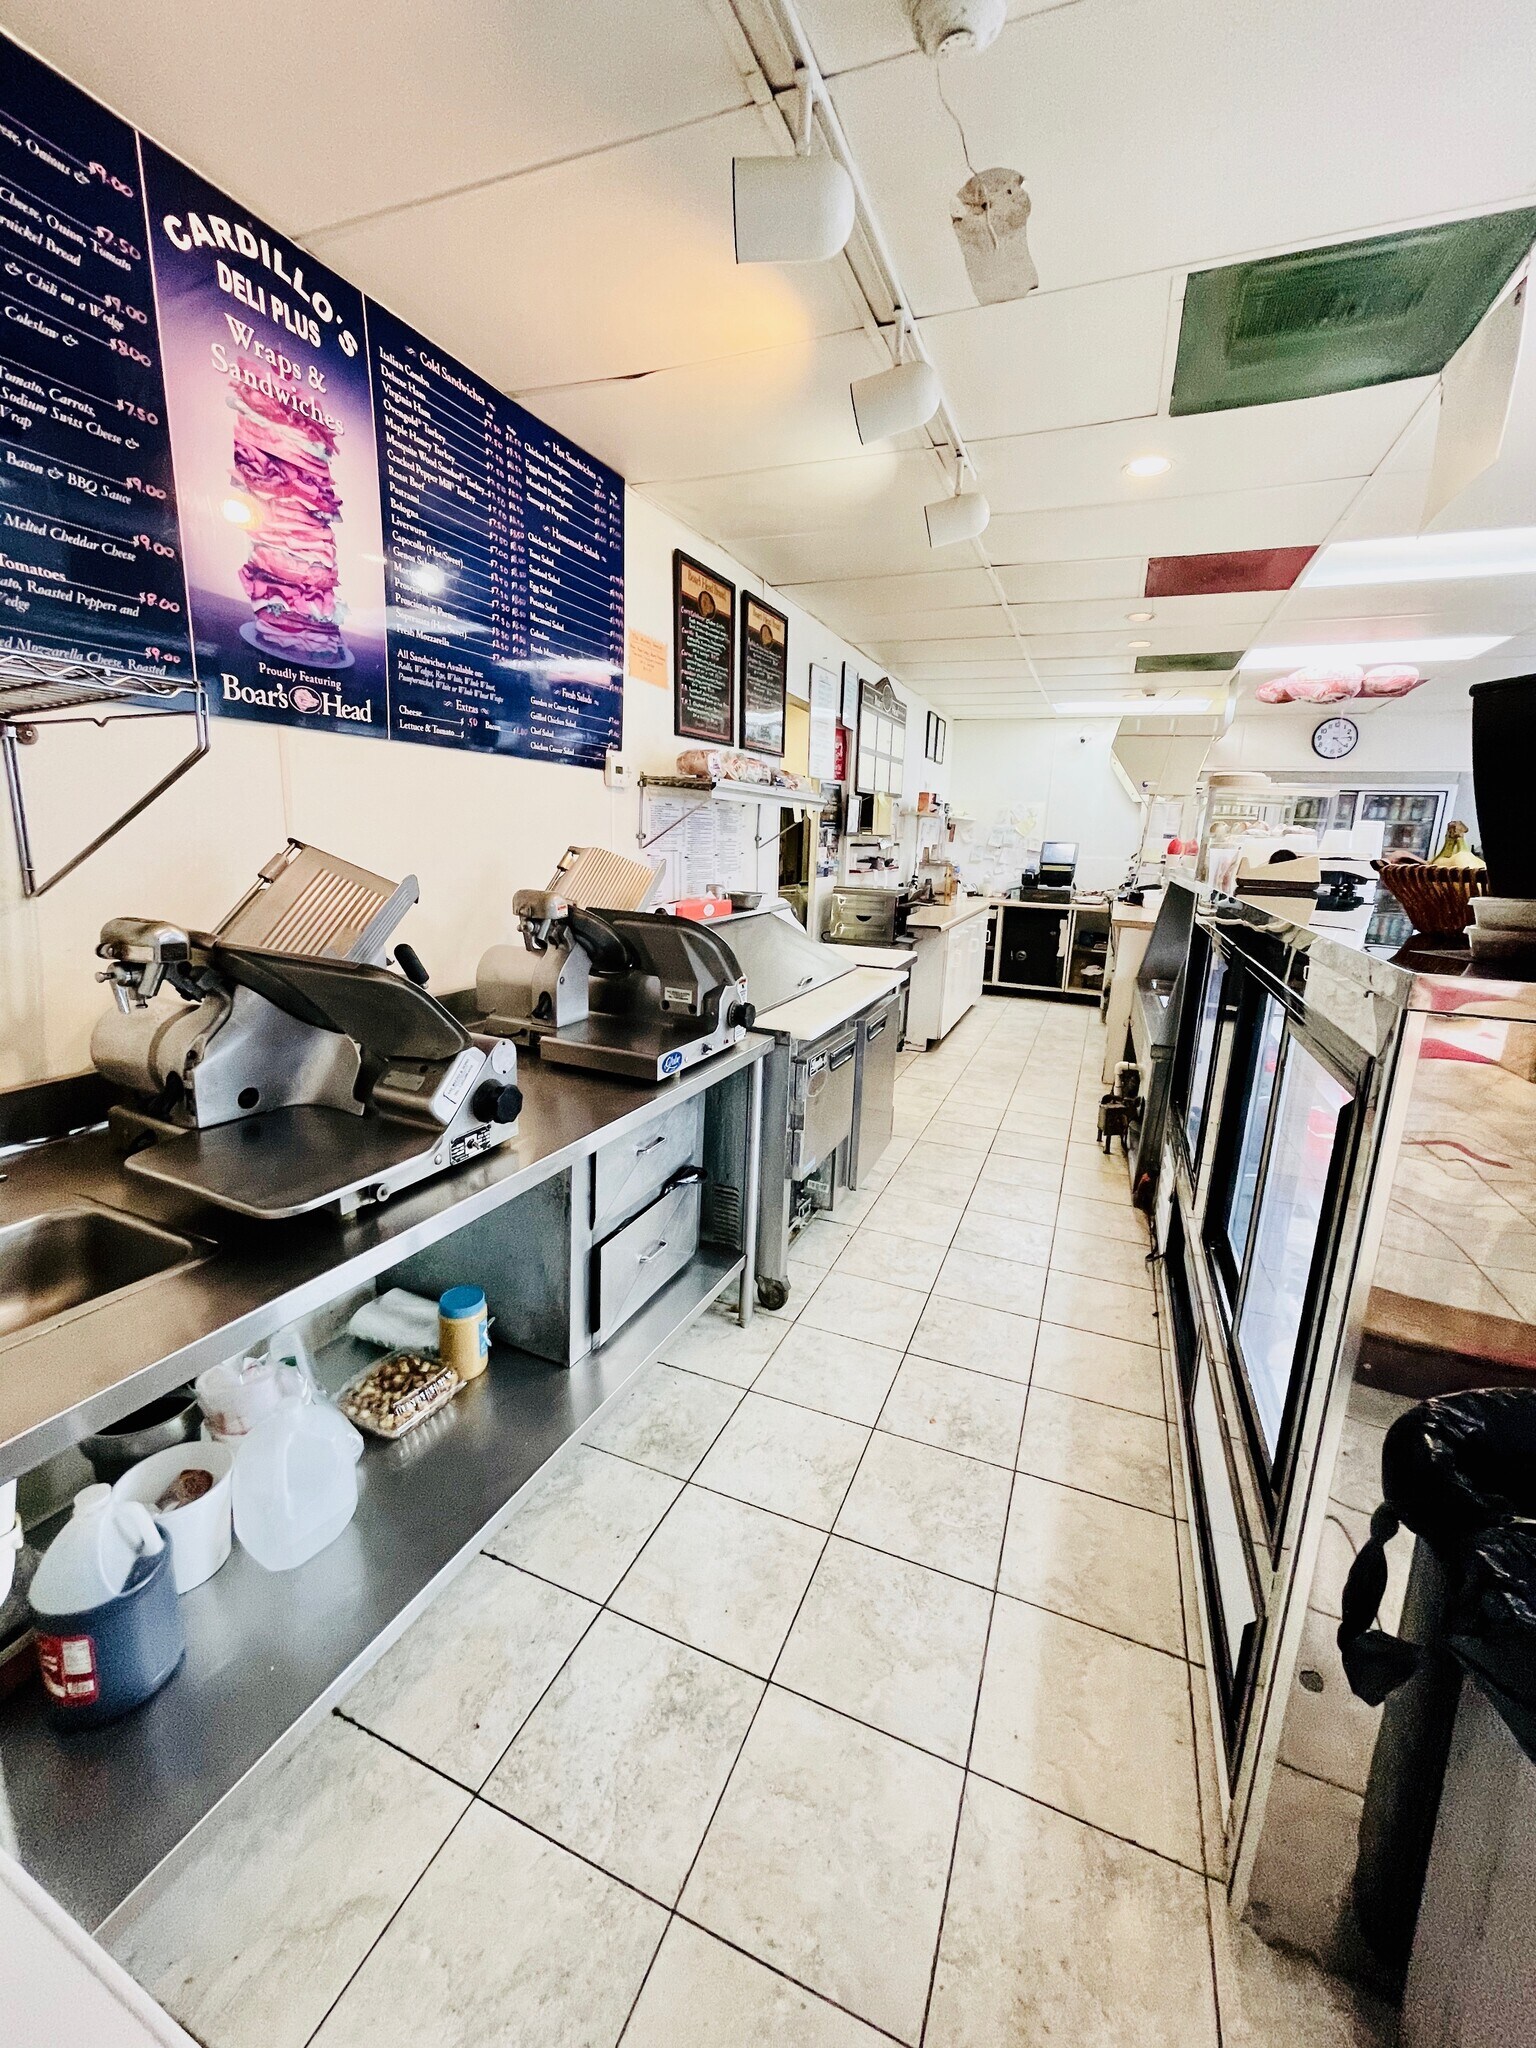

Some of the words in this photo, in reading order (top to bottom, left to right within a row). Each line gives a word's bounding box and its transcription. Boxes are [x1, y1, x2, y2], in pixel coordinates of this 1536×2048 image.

[26, 138, 70, 175] Onions
[46, 213, 87, 248] Onion,
[90, 237, 132, 271] Tomato
[46, 236, 81, 267] Bread
[26, 272, 58, 297] Chili
[60, 292, 75, 306] on
[78, 302, 87, 311] a
[89, 302, 125, 333] Wedge
[104, 294, 148, 325] $9.00
[216, 259, 267, 316] DELI
[270, 293, 322, 348] PLUS
[5, 305, 60, 339] Coleslaw
[223, 312, 303, 382] Wraps
[307, 365, 328, 394] &
[379, 345, 405, 372] Italian
[210, 342, 345, 436] Sandwiches
[407, 381, 427, 401] Ham
[419, 351, 442, 376] Cold
[441, 366, 486, 406] Sandwiches
[49, 387, 97, 419] Carrots,
[117, 398, 159, 426] $7.50
[381, 379, 413, 409] Virginia
[413, 400, 432, 420] Ham
[1, 386, 48, 415] Sodium
[51, 405, 84, 429] Swiss
[86, 421, 123, 445] Cheese
[384, 414, 409, 438] Maple
[408, 428, 433, 452] Honey
[432, 441, 456, 466] Turkey
[422, 420, 446, 445] Turkey
[417, 448, 438, 469] Wood
[465, 474, 487, 497] Turkey
[551, 441, 566, 460] Hot
[564, 451, 597, 480] Sandwiches
[6, 450, 45, 475] Bacon
[47, 466, 65, 480] &
[67, 471, 98, 497] BBQ
[101, 484, 133, 505] Sauce
[125, 476, 167, 500] $9.00
[387, 448, 416, 473] Cracked
[415, 463, 439, 485] Pepper
[455, 484, 477, 505] Turkey
[388, 464, 410, 484] Roast
[409, 475, 426, 492] Beef
[389, 480, 421, 504] Pastrami
[390, 496, 420, 519] Bologna
[3, 512, 47, 537] Melted
[50, 526, 101, 551] Cheddar
[101, 542, 137, 562] Cheese
[391, 513, 428, 538] Liverwurst
[132, 533, 176, 559] $9.00
[391, 529, 426, 552] Capocollo
[551, 526, 584, 553] Homemade
[581, 542, 600, 561] Salads
[0, 552, 67, 582] Tomatoes
[27, 578, 75, 604] Roasted
[77, 590, 118, 612] Peppers
[119, 604, 141, 618] and
[139, 591, 181, 614] $8.00
[528, 578, 540, 595] Egg
[539, 584, 553, 599] Salad
[543, 601, 558, 615] Salad
[396, 625, 416, 640] Fresh
[415, 630, 450, 647] Mozzarella
[550, 618, 565, 632] Salad
[16, 637, 85, 661] Mozzarella
[128, 658, 168, 677] Roasted
[144, 646, 182, 663] $9.00
[397, 648, 409, 660] All
[409, 650, 447, 670] Sandwiches
[446, 661, 475, 676] Available
[258, 661, 298, 683] Proudly
[299, 670, 343, 692] Featuring
[220, 672, 290, 710] Boar's
[321, 692, 373, 723] Head
[455, 699, 480, 714] Extras
[529, 695, 548, 709] Garden
[565, 704, 580, 715] Salad
[560, 687, 577, 701] Fresh
[575, 691, 593, 705] Salads
[398, 704, 423, 718] Cheese
[529, 711, 547, 724] Grilled
[546, 715, 565, 727] Chicken
[563, 718, 578, 729] Salad
[398, 718, 425, 733] Lettuce
[424, 723, 433, 733] &
[431, 724, 457, 738] Tomato
[529, 727, 542, 738] Chef
[540, 729, 556, 742] Salad
[529, 741, 549, 753] Chicken
[560, 747, 576, 757] Salad
